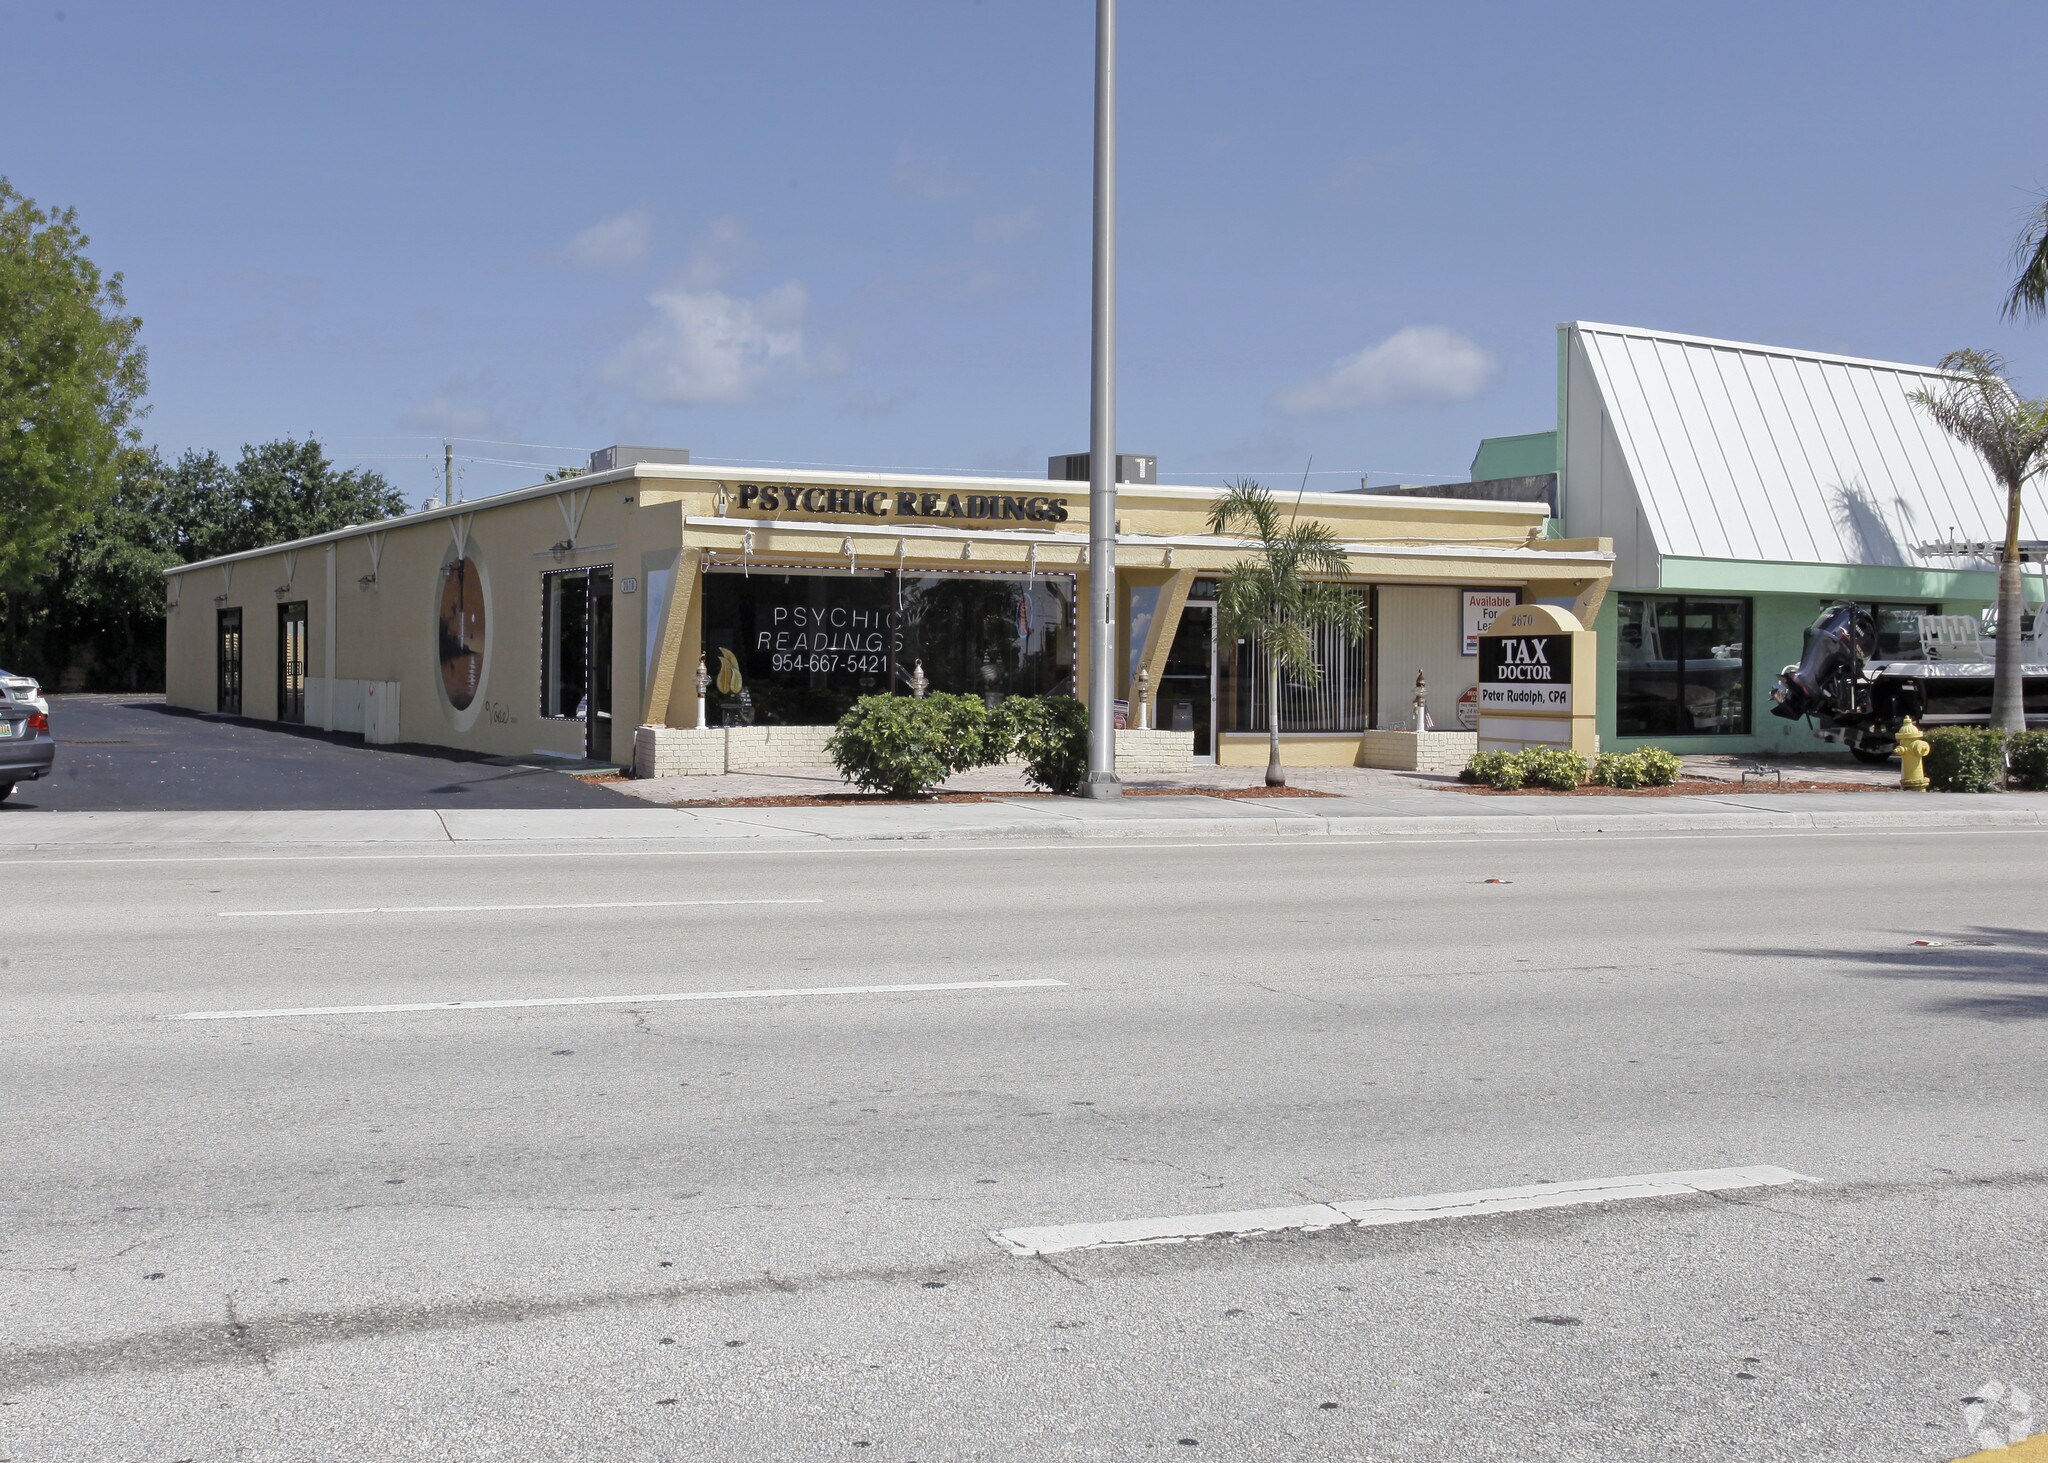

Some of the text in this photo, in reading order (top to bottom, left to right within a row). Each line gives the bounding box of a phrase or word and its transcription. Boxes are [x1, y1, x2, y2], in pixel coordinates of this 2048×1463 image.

[737, 484, 1068, 523] PSYCHIC READINGS
[1469, 596, 1511, 607] Available
[774, 607, 902, 630] PSYCHIC
[1483, 609, 1498, 619] For
[1511, 615, 1533, 627] 2670
[1477, 621, 1492, 632] Lea
[757, 631, 904, 652] READINGS
[1501, 638, 1548, 664] TAX
[772, 653, 888, 673] 954-667-5421
[1498, 665, 1552, 680] DOCTOR
[1482, 689, 1567, 705] Peter Rudolph, CPA
